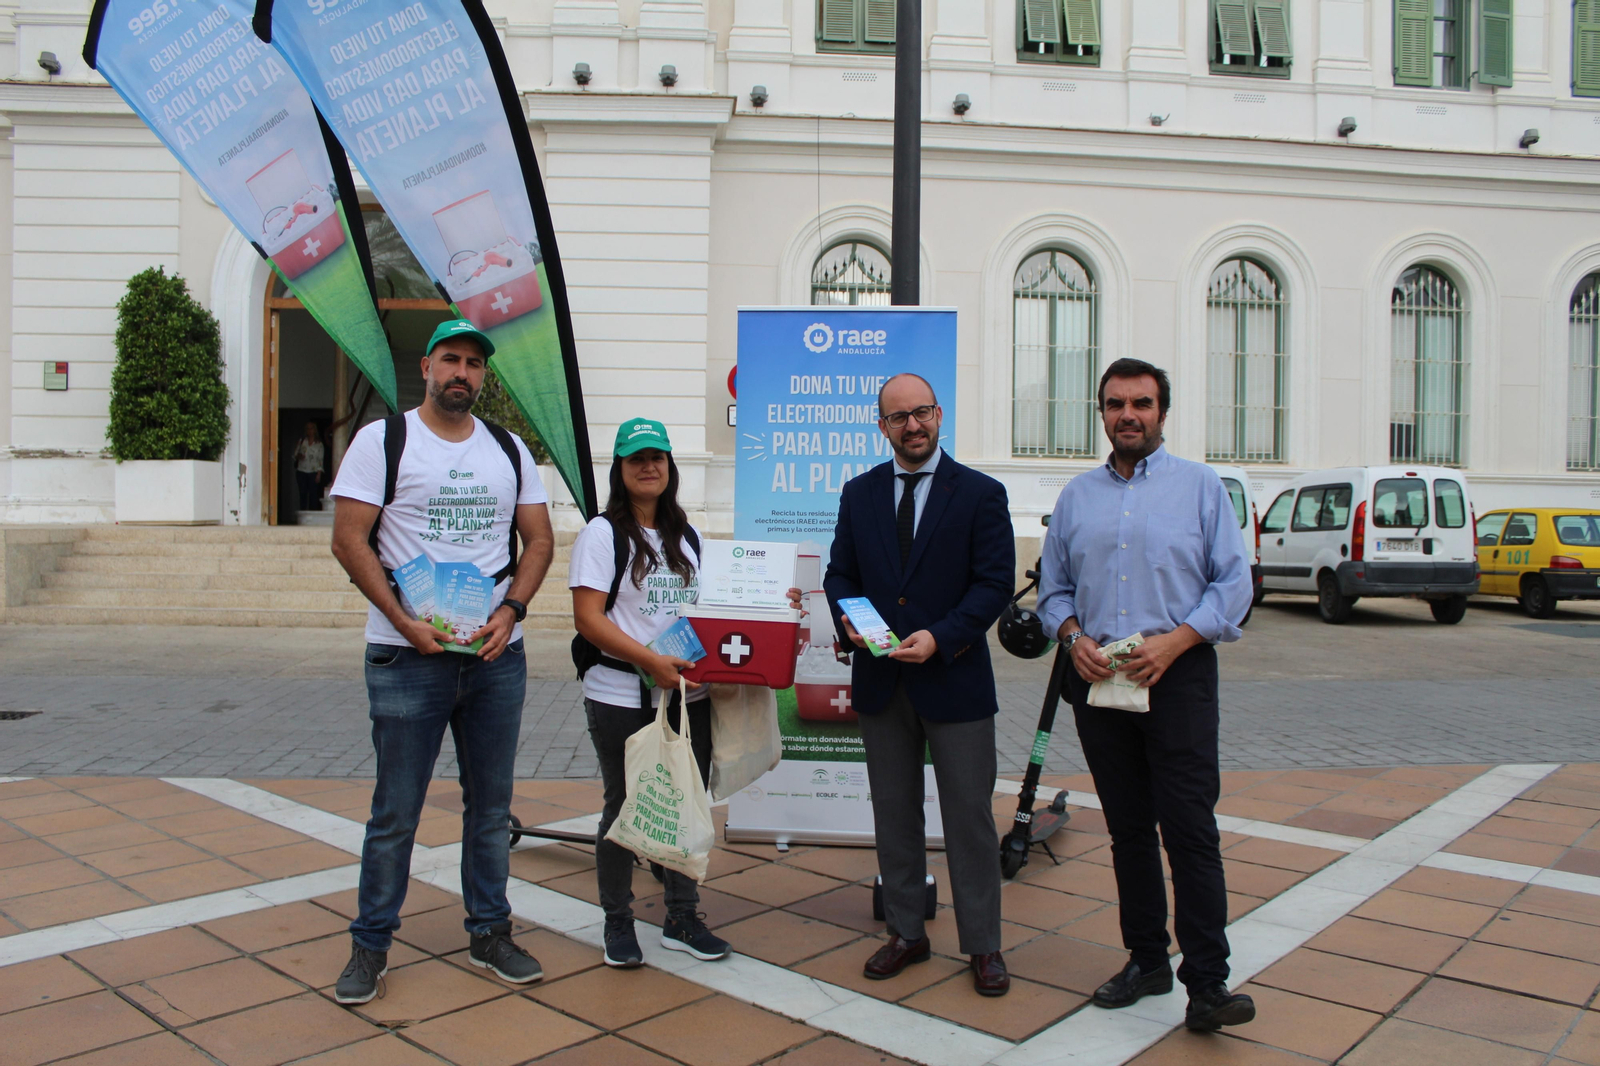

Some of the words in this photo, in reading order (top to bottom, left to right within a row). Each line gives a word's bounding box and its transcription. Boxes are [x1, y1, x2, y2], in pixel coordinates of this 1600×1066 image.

[837, 329, 887, 346] raee
[837, 347, 886, 355] ANDALUCÍA
[790, 375, 832, 395] DONA
[836, 376, 856, 395] TU
[859, 376, 891, 395] VIE
[767, 402, 878, 424] ELECTRODOMÉ
[772, 431, 823, 456] PARA
[828, 432, 867, 456] DAR
[872, 432, 894, 457] VI
[771, 462, 803, 493] AL
[809, 462, 876, 493] PLA
[440, 486, 458, 495] DONA
[459, 486, 469, 495] TU
[469, 485, 488, 494] VIEJO
[428, 496, 498, 506] ELECTRODOMÉSTICO
[428, 507, 453, 518] PARA
[455, 508, 474, 519] DAR
[476, 507, 496, 518] VIDA
[771, 509, 796, 517] Recicla
[428, 518, 444, 531] AL
[754, 517, 796, 525] electrónicos
[746, 549, 766, 557] raee
[1507, 550, 1530, 565] 101
[647, 577, 668, 588] PARA
[669, 577, 683, 588] DAR
[647, 590, 660, 604] AL
[787, 744, 809, 752] saber
[809, 744, 834, 752] dónde
[636, 803, 652, 820] PARA
[632, 815, 642, 830] AL
[643, 821, 676, 846] PLANETA
